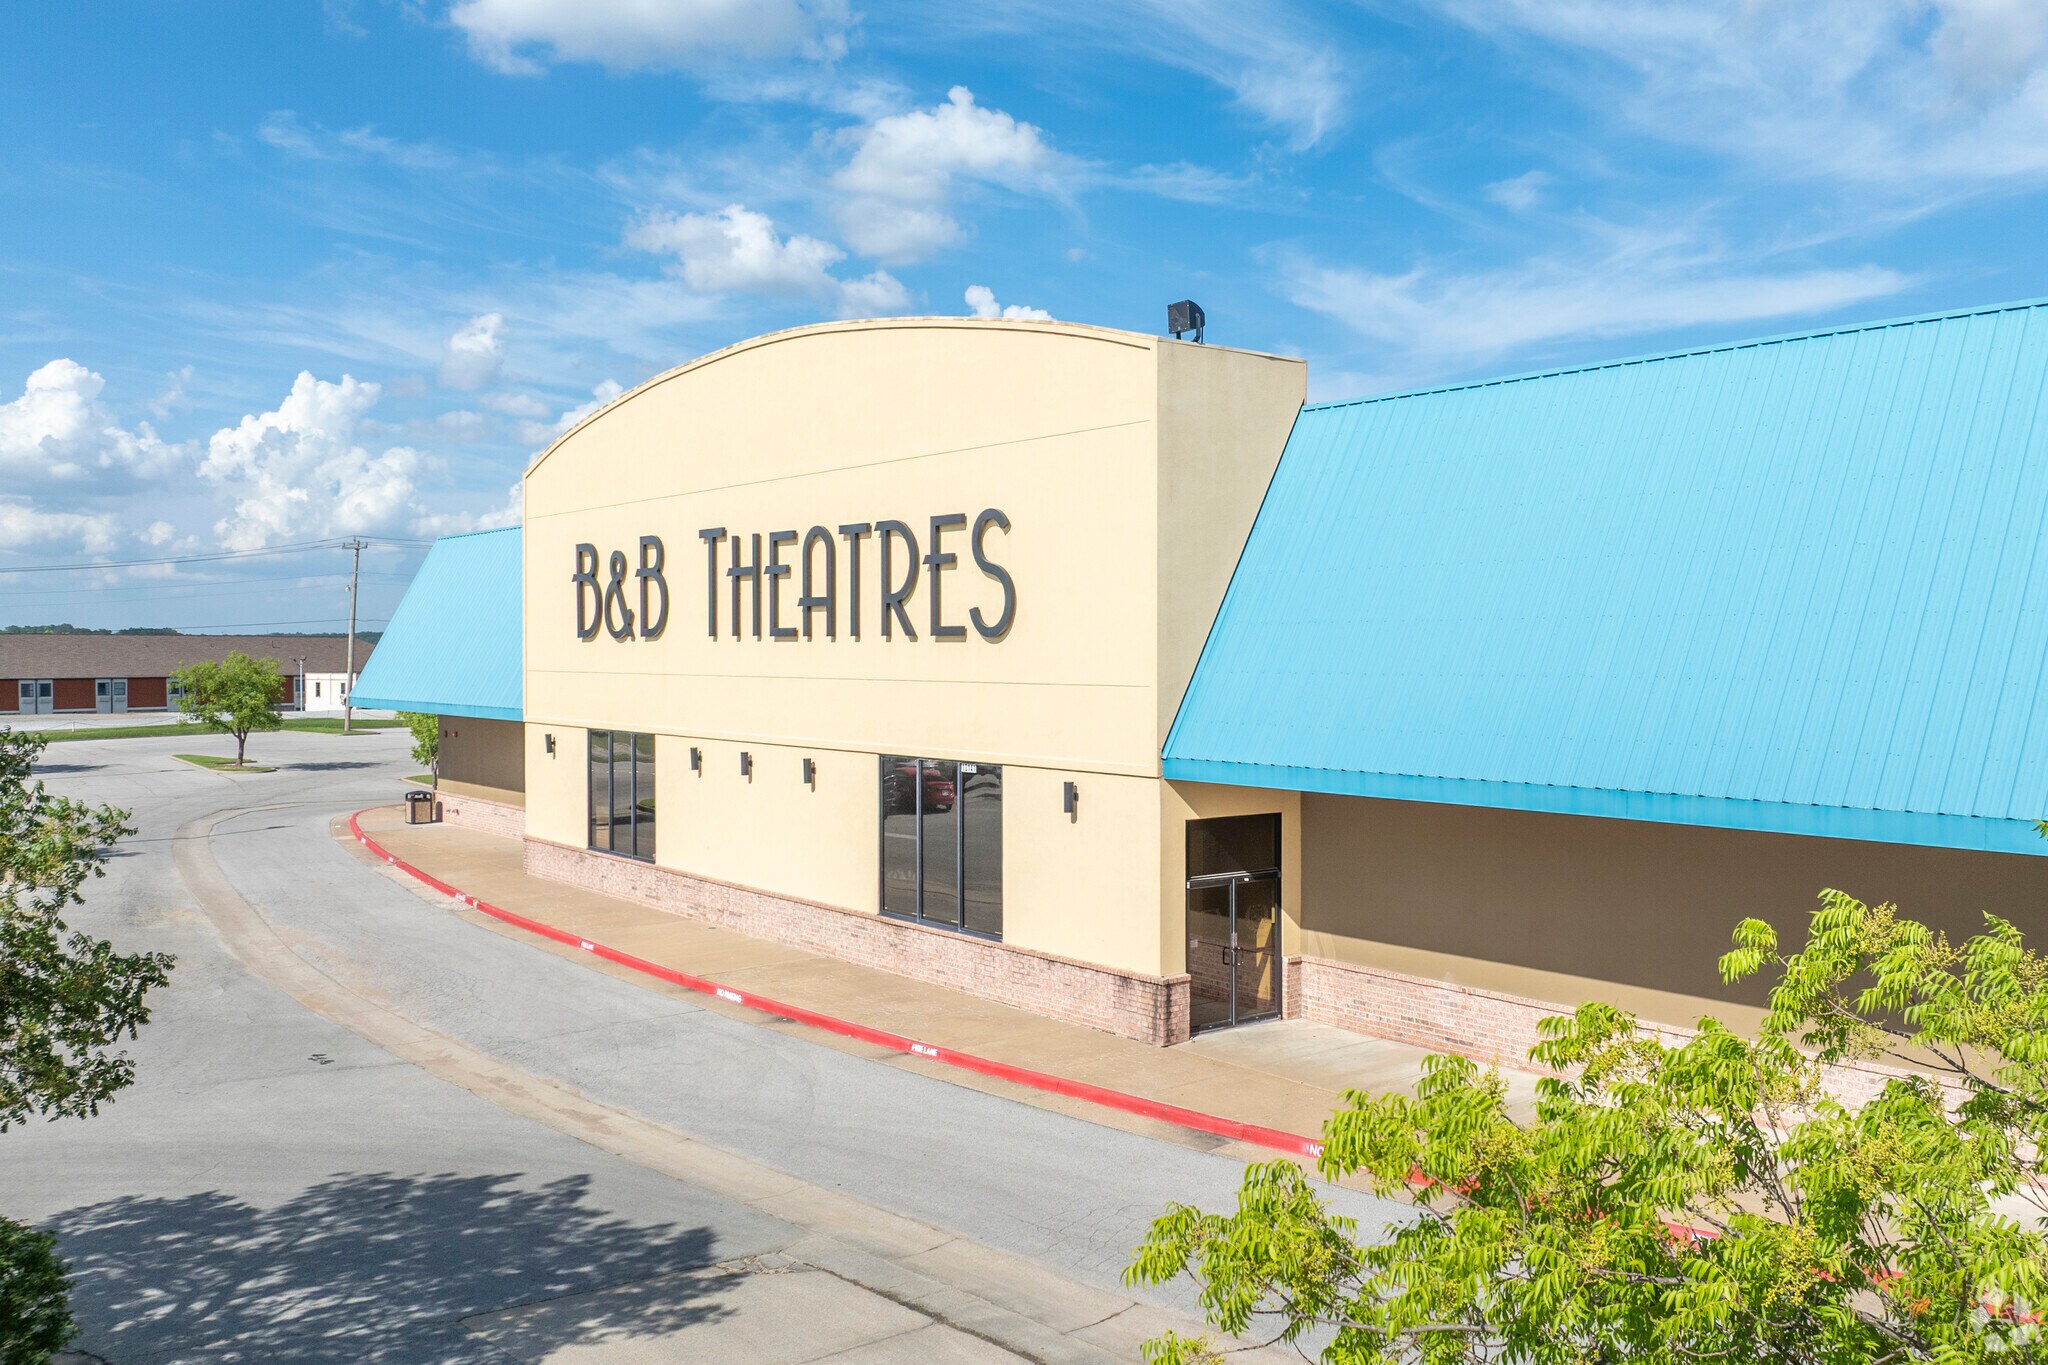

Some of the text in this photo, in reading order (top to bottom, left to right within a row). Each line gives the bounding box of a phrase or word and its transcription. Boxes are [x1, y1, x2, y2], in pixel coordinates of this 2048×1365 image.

[571, 508, 1016, 644] B&B THEATRES
[911, 1043, 938, 1057] FIRE LANE
